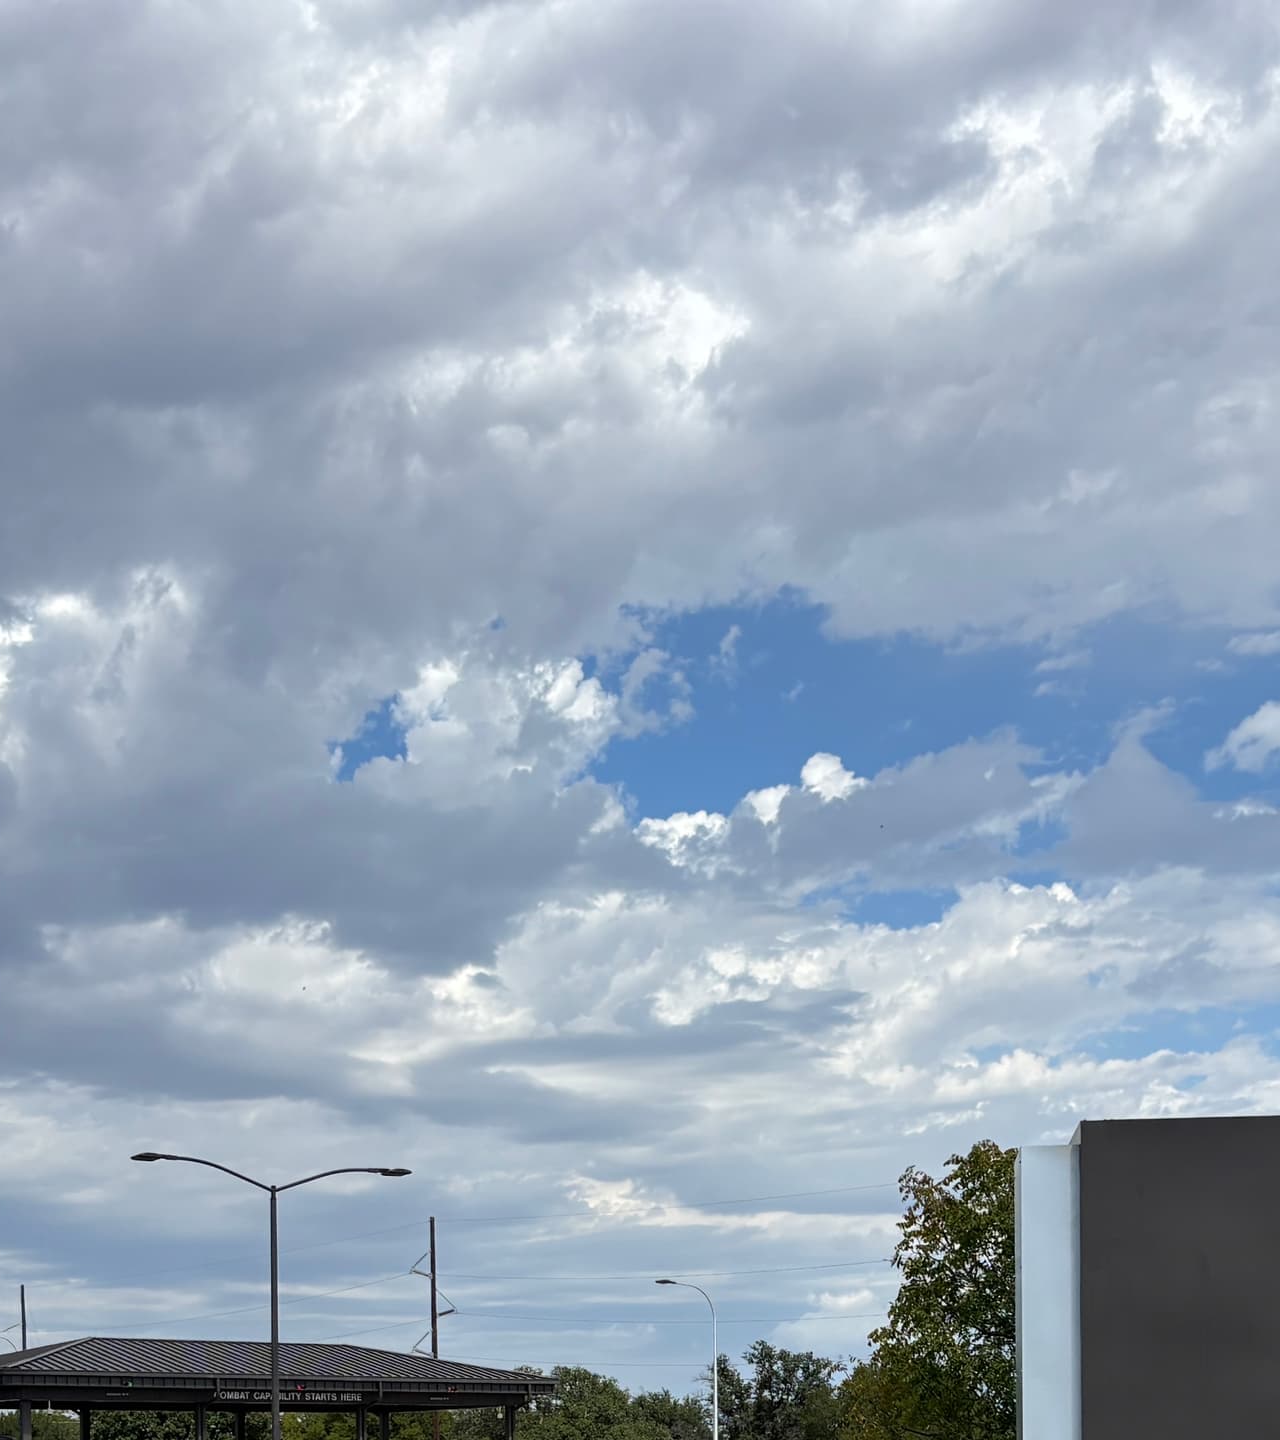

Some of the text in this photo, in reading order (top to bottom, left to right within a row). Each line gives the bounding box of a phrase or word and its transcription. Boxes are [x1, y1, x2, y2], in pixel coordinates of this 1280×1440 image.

[214, 1391, 250, 1400] OMBAT
[305, 1392, 337, 1401] STARTS
[341, 1393, 362, 1402] HERE
